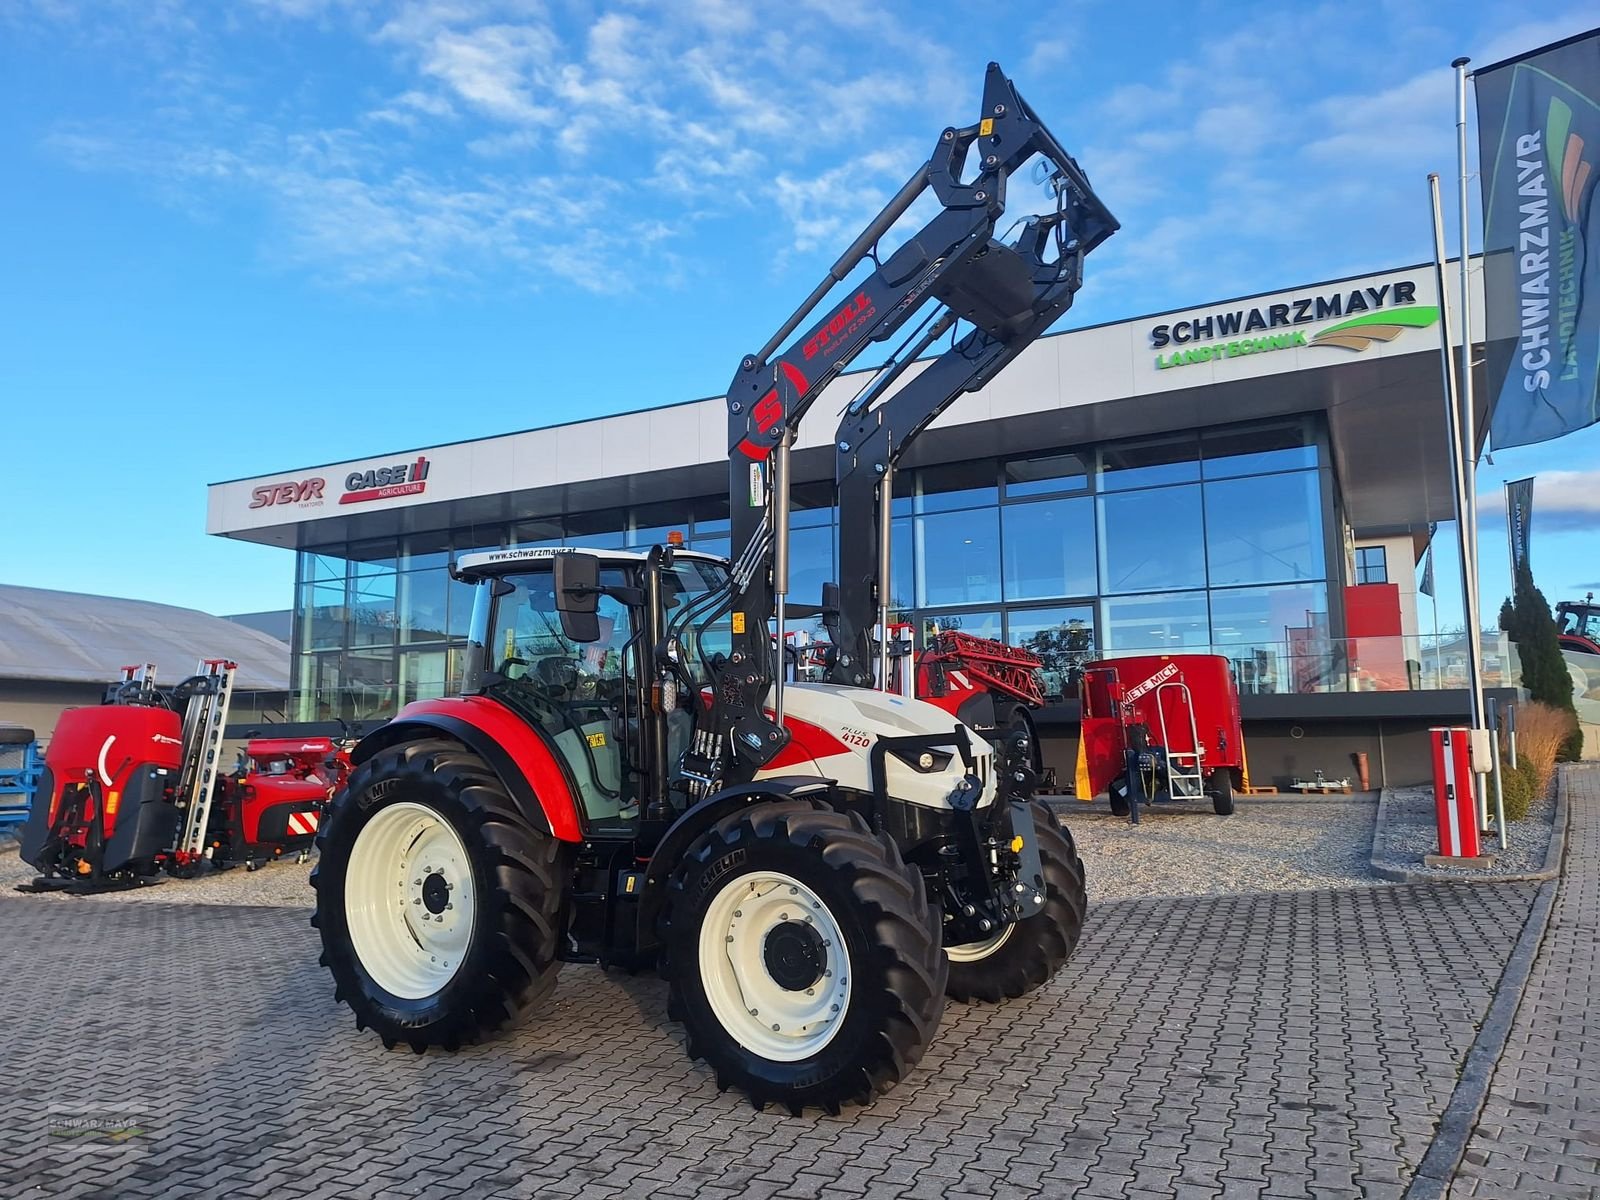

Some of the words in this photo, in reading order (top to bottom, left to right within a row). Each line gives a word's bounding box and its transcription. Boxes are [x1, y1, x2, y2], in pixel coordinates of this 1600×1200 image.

[1516, 130, 1550, 392] SCHWARZMAYR
[1151, 281, 1416, 348] SCHWARZMAYR
[1559, 226, 1578, 382] LANDTECHNIK
[803, 291, 871, 361] STOLL
[1158, 329, 1307, 369] LANDTECHNIK
[345, 465, 408, 491] CASE
[378, 484, 421, 497] AGRICULTURE
[249, 478, 325, 509] STEYR
[489, 547, 576, 560] www.schwarzmayrat
[1150, 664, 1177, 686] MICH
[841, 726, 868, 737] PLUS
[842, 732, 870, 748] 4120
